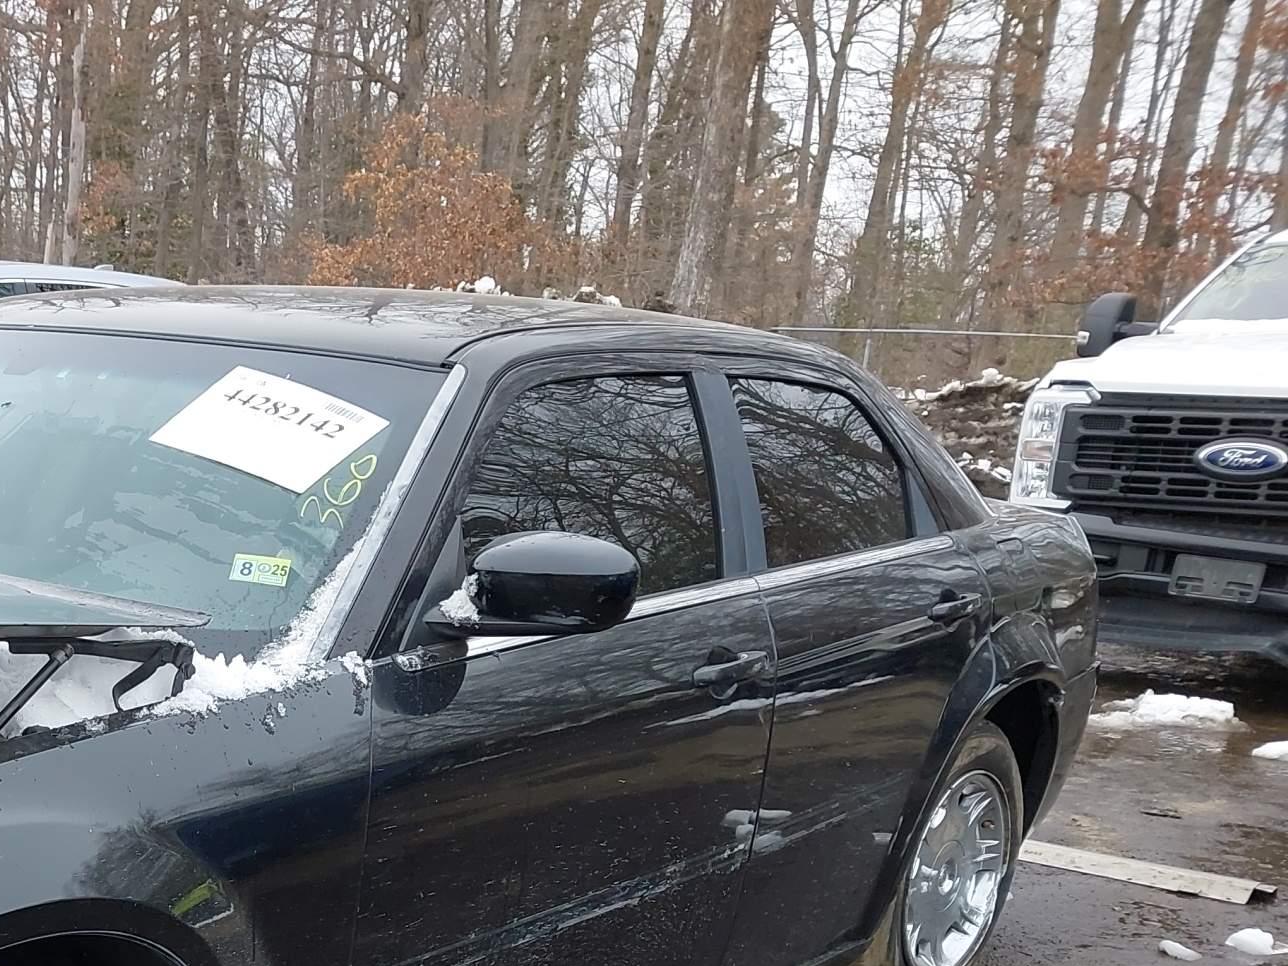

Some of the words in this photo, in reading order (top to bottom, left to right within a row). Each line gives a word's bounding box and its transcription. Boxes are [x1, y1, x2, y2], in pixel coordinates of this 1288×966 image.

[223, 388, 345, 439] 44282142
[1218, 448, 1269, 467] Ford
[300, 454, 378, 529] 360
[239, 561, 253, 576] 8
[271, 564, 288, 577] 25
